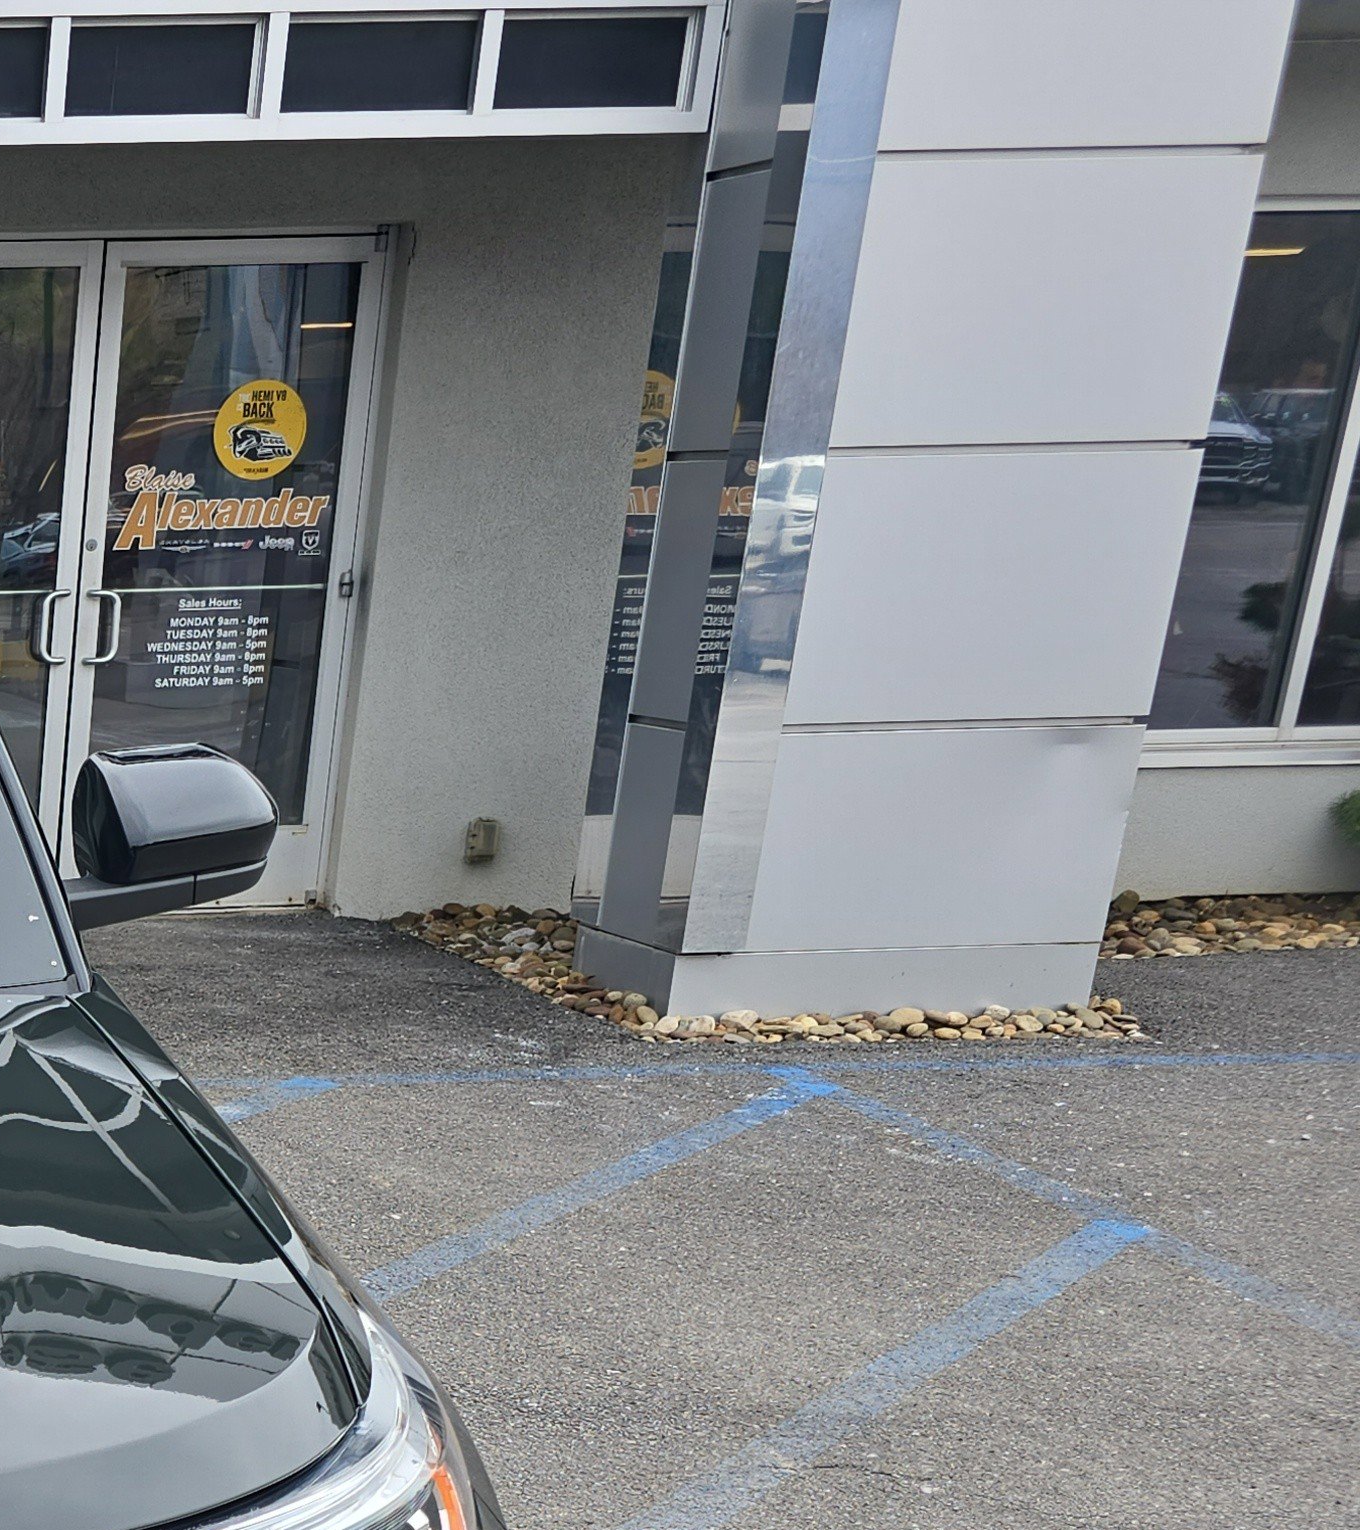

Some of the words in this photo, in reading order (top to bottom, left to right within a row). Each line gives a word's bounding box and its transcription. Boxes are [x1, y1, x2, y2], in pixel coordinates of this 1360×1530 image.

[252, 390, 274, 402] HEMI
[275, 390, 287, 401] V8
[242, 402, 275, 418] BACK
[125, 464, 196, 491] Blaise
[112, 488, 330, 551] Alexander
[259, 535, 295, 551] Jeep
[179, 599, 206, 608] Sales
[170, 616, 216, 627] MONDAY
[217, 616, 238, 626] 9am
[247, 615, 269, 626] 8pm
[166, 629, 214, 639] TUESDAY
[216, 629, 237, 638] 9am
[246, 628, 268, 638] 8pm
[147, 641, 213, 652] WEDNESDAY
[215, 641, 236, 650] 9am
[245, 640, 267, 651] 5pm
[156, 653, 212, 664] THURSDAY
[214, 653, 235, 662] 9am
[244, 652, 266, 662] 8pm
[173, 665, 211, 675] FRIDAY
[213, 665, 234, 674] 9am
[243, 664, 264, 675] 8pm
[155, 677, 211, 688] SATURDAY
[212, 677, 233, 686] 9am
[242, 676, 264, 687] 5pm
